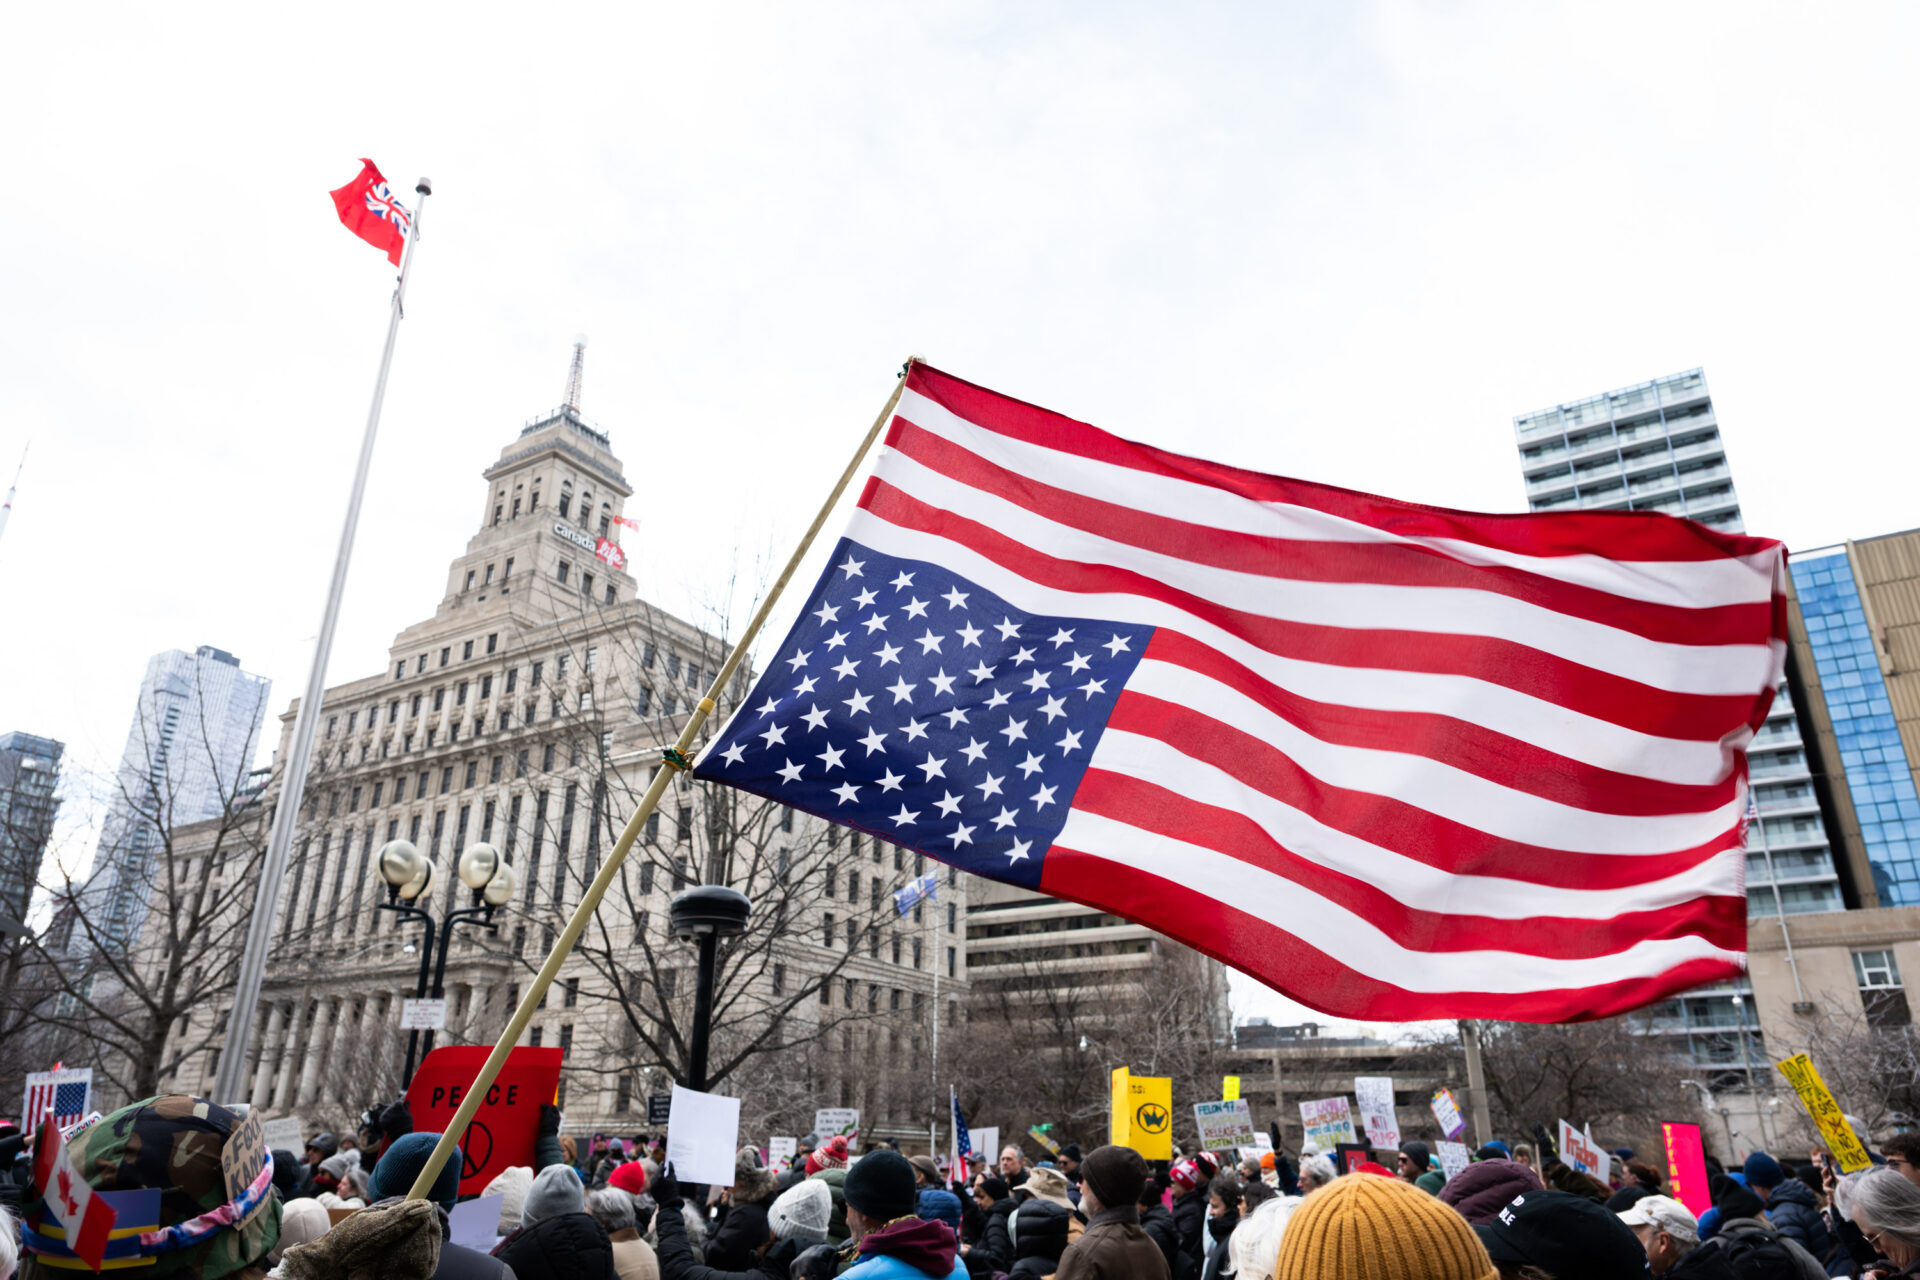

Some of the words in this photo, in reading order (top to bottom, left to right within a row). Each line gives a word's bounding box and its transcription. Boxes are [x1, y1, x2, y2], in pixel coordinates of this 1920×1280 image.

[554, 523, 596, 553] canada
[597, 541, 624, 566] life
[431, 1084, 518, 1108] PECE
[1198, 1103, 1222, 1115] FELON
[1223, 1101, 1234, 1113] 47
